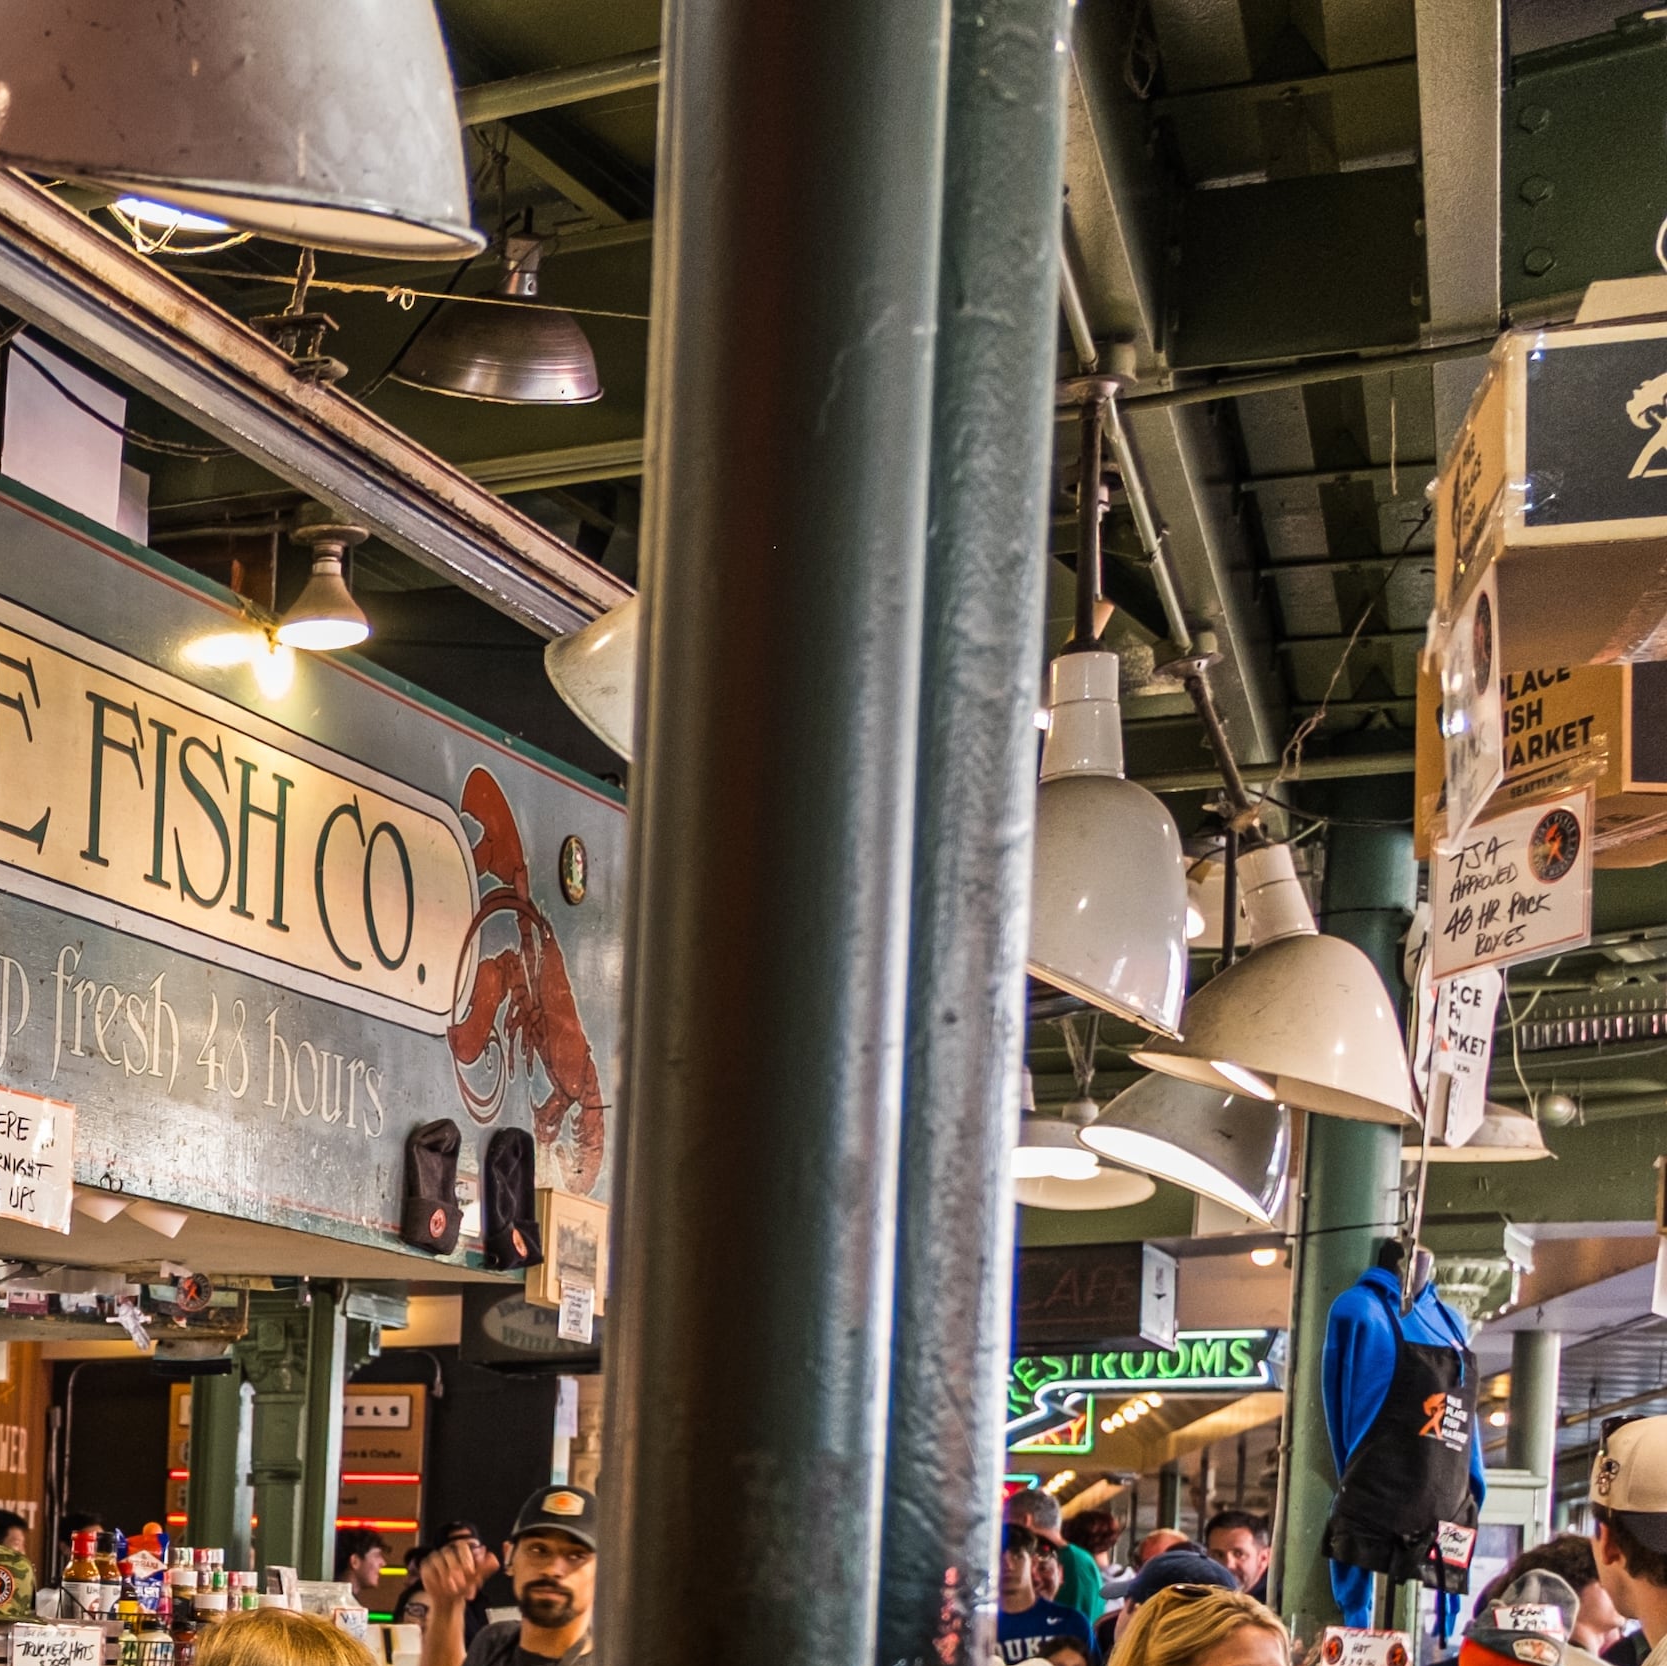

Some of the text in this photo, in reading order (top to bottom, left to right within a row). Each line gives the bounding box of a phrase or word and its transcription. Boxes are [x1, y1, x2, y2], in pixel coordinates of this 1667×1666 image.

[1503, 702, 1544, 737] ISH
[79, 689, 297, 934] FISH
[313, 793, 429, 986] CO.
[1450, 861, 1520, 904] APPROVED
[1443, 904, 1474, 942] 48
[1508, 891, 1552, 922] PACK
[51, 944, 180, 1094] fresh
[195, 992, 250, 1100] 48
[263, 1006, 385, 1139] hours
[9, 1186, 37, 1213] UPS
[16, 1641, 96, 1661] TRUCKER HATS
